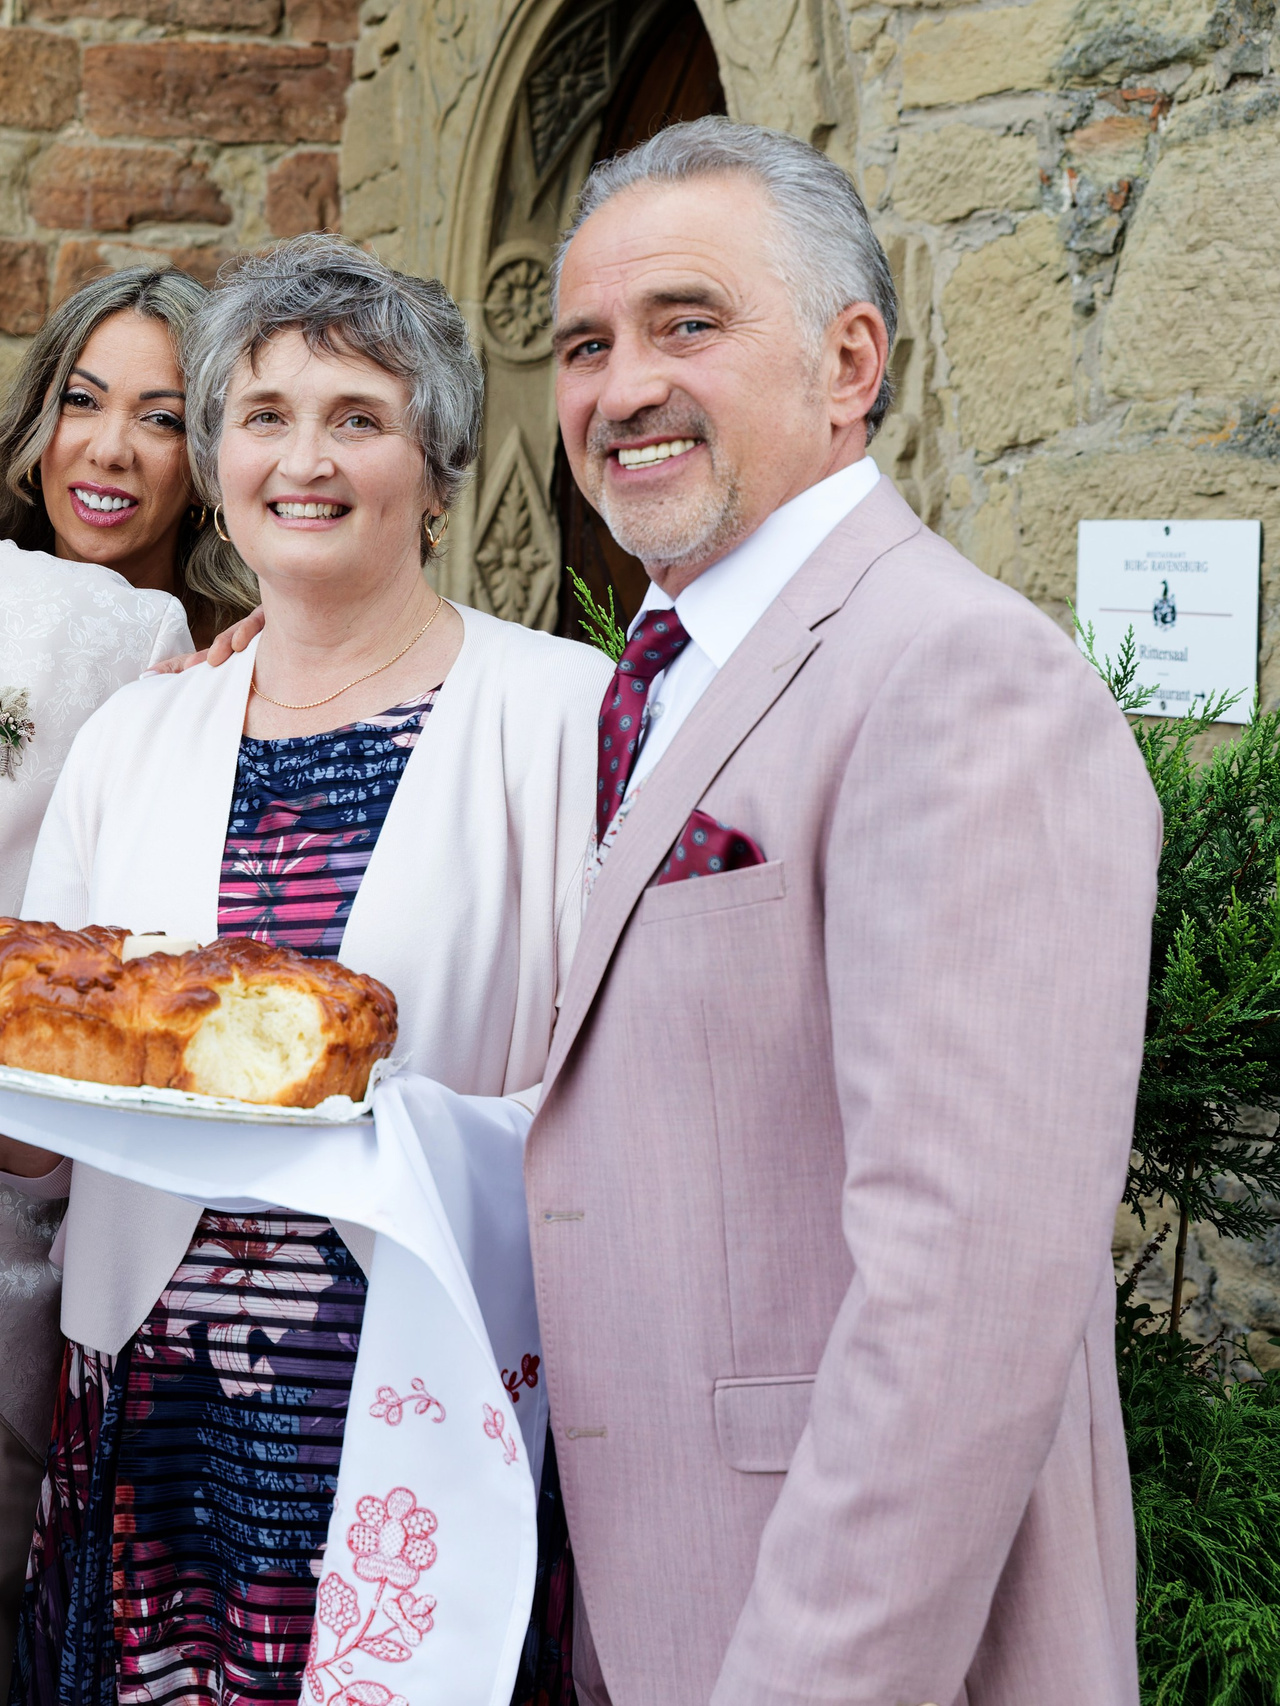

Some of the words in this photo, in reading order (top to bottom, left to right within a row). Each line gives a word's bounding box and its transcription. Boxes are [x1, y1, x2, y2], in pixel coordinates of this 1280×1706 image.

[1124, 560, 1148, 571] BURG
[1151, 561, 1208, 573] RAVENSBURG
[1139, 645, 1188, 662] Rittersaal
